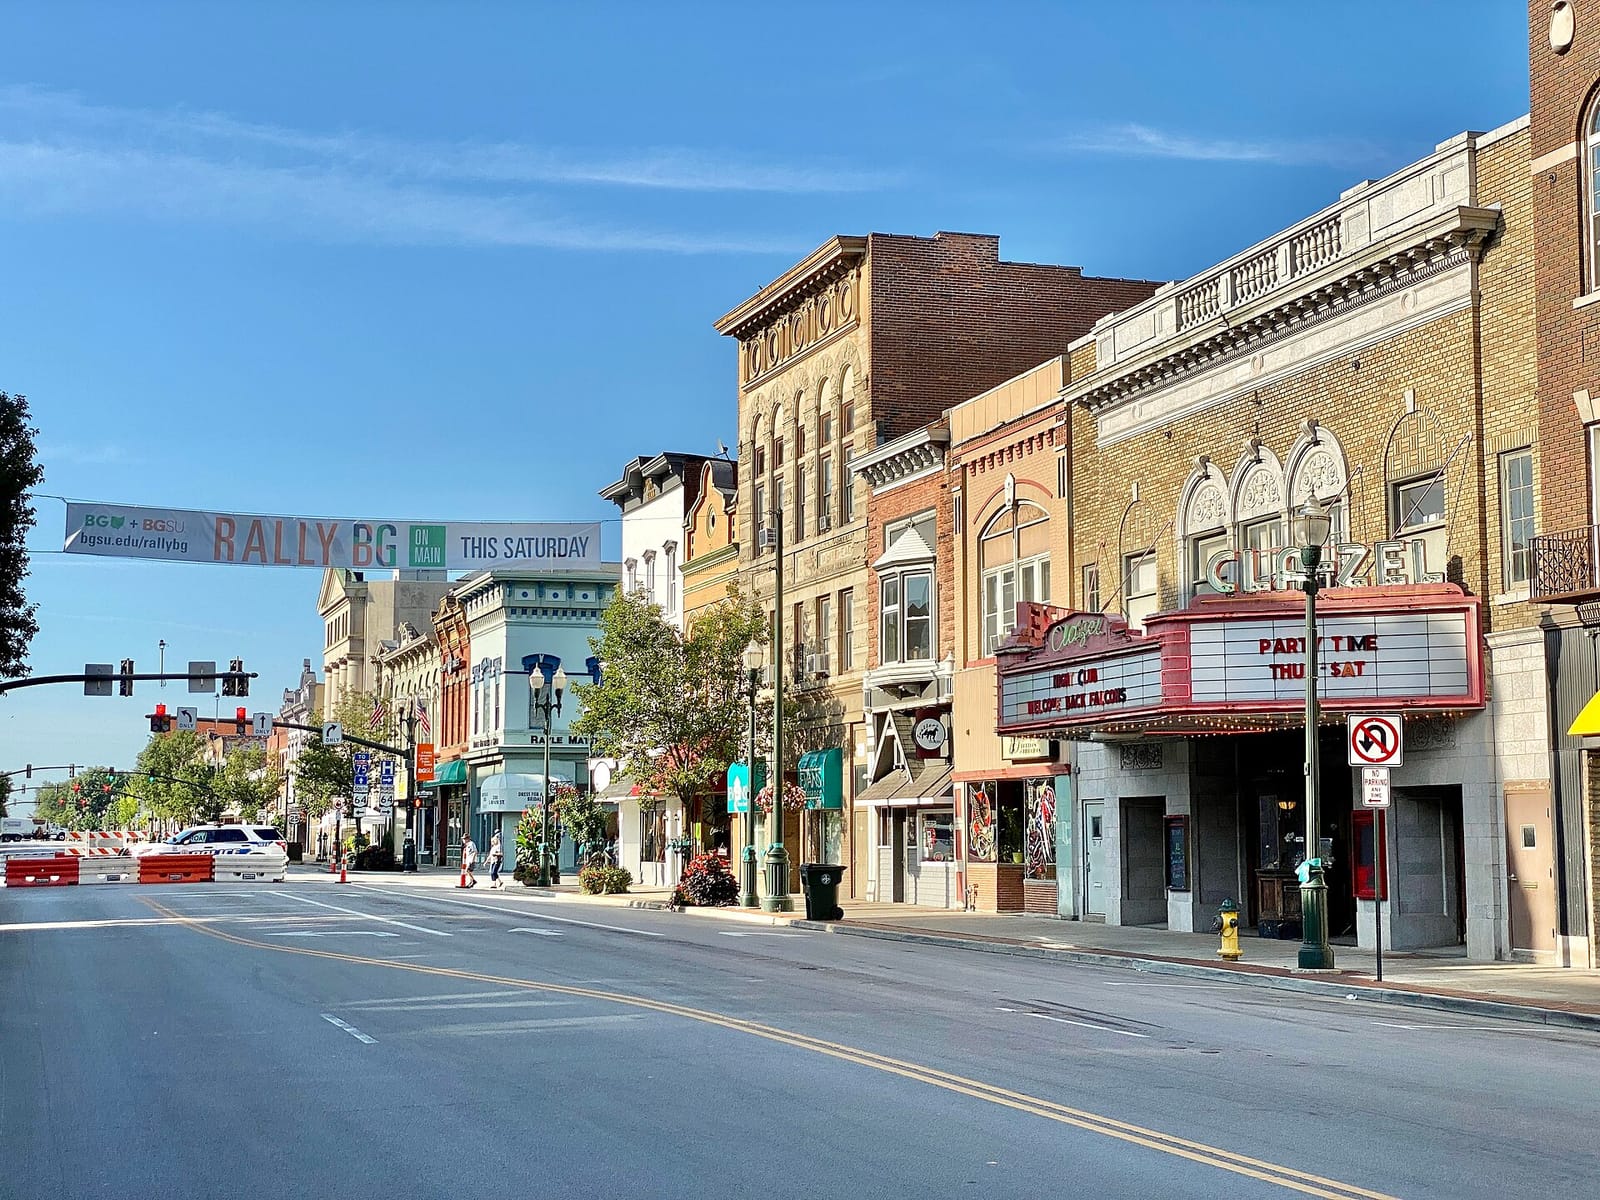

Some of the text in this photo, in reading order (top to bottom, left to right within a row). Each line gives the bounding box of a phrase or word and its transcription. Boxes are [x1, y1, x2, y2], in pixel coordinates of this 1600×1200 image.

[84, 514, 109, 528] BG
[142, 518, 185, 534] BGSU
[80, 532, 188, 553] bgsu.edu/rallybg
[213, 516, 397, 567] RALLY BG
[415, 528, 429, 545] ON
[414, 546, 441, 563] MAIN
[460, 535, 590, 559] THIS SATURDAY
[1077, 668, 1098, 686] CLUB
[1027, 687, 1127, 715] WELCOME BACK FALCONS
[531, 735, 563, 744] RALE
[356, 765, 367, 773] 75
[355, 796, 366, 804] 64
[380, 796, 393, 804] 64
